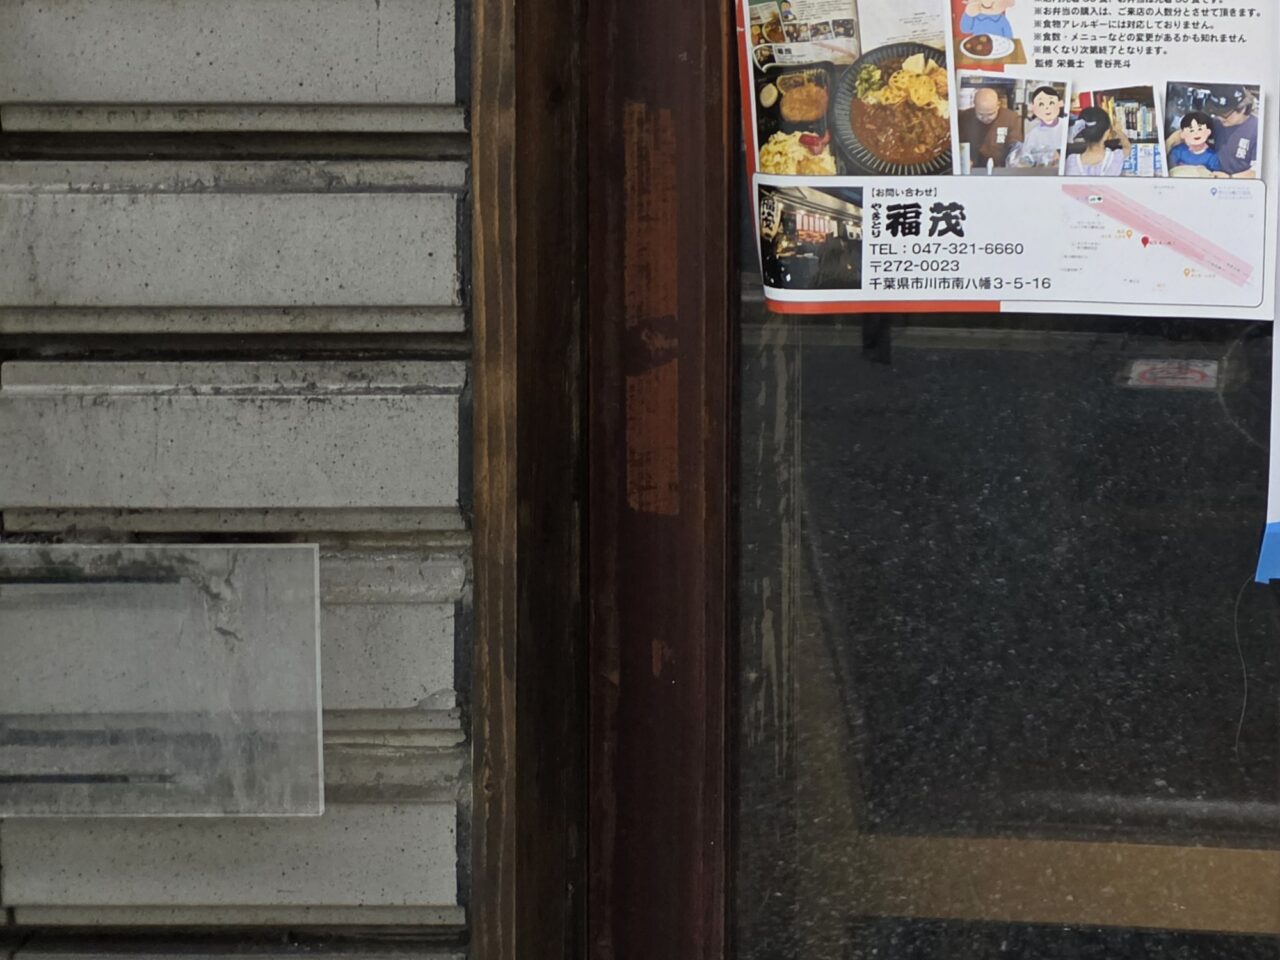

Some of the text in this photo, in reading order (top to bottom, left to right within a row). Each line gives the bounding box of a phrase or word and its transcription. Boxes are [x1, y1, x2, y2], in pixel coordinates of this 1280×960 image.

[871, 203, 882, 238] やきとり
[885, 201, 967, 238] 福茂
[869, 260, 960, 272] 〒272-0023
[869, 277, 1051, 290] 千葉県市川市南八幡3-5-16
